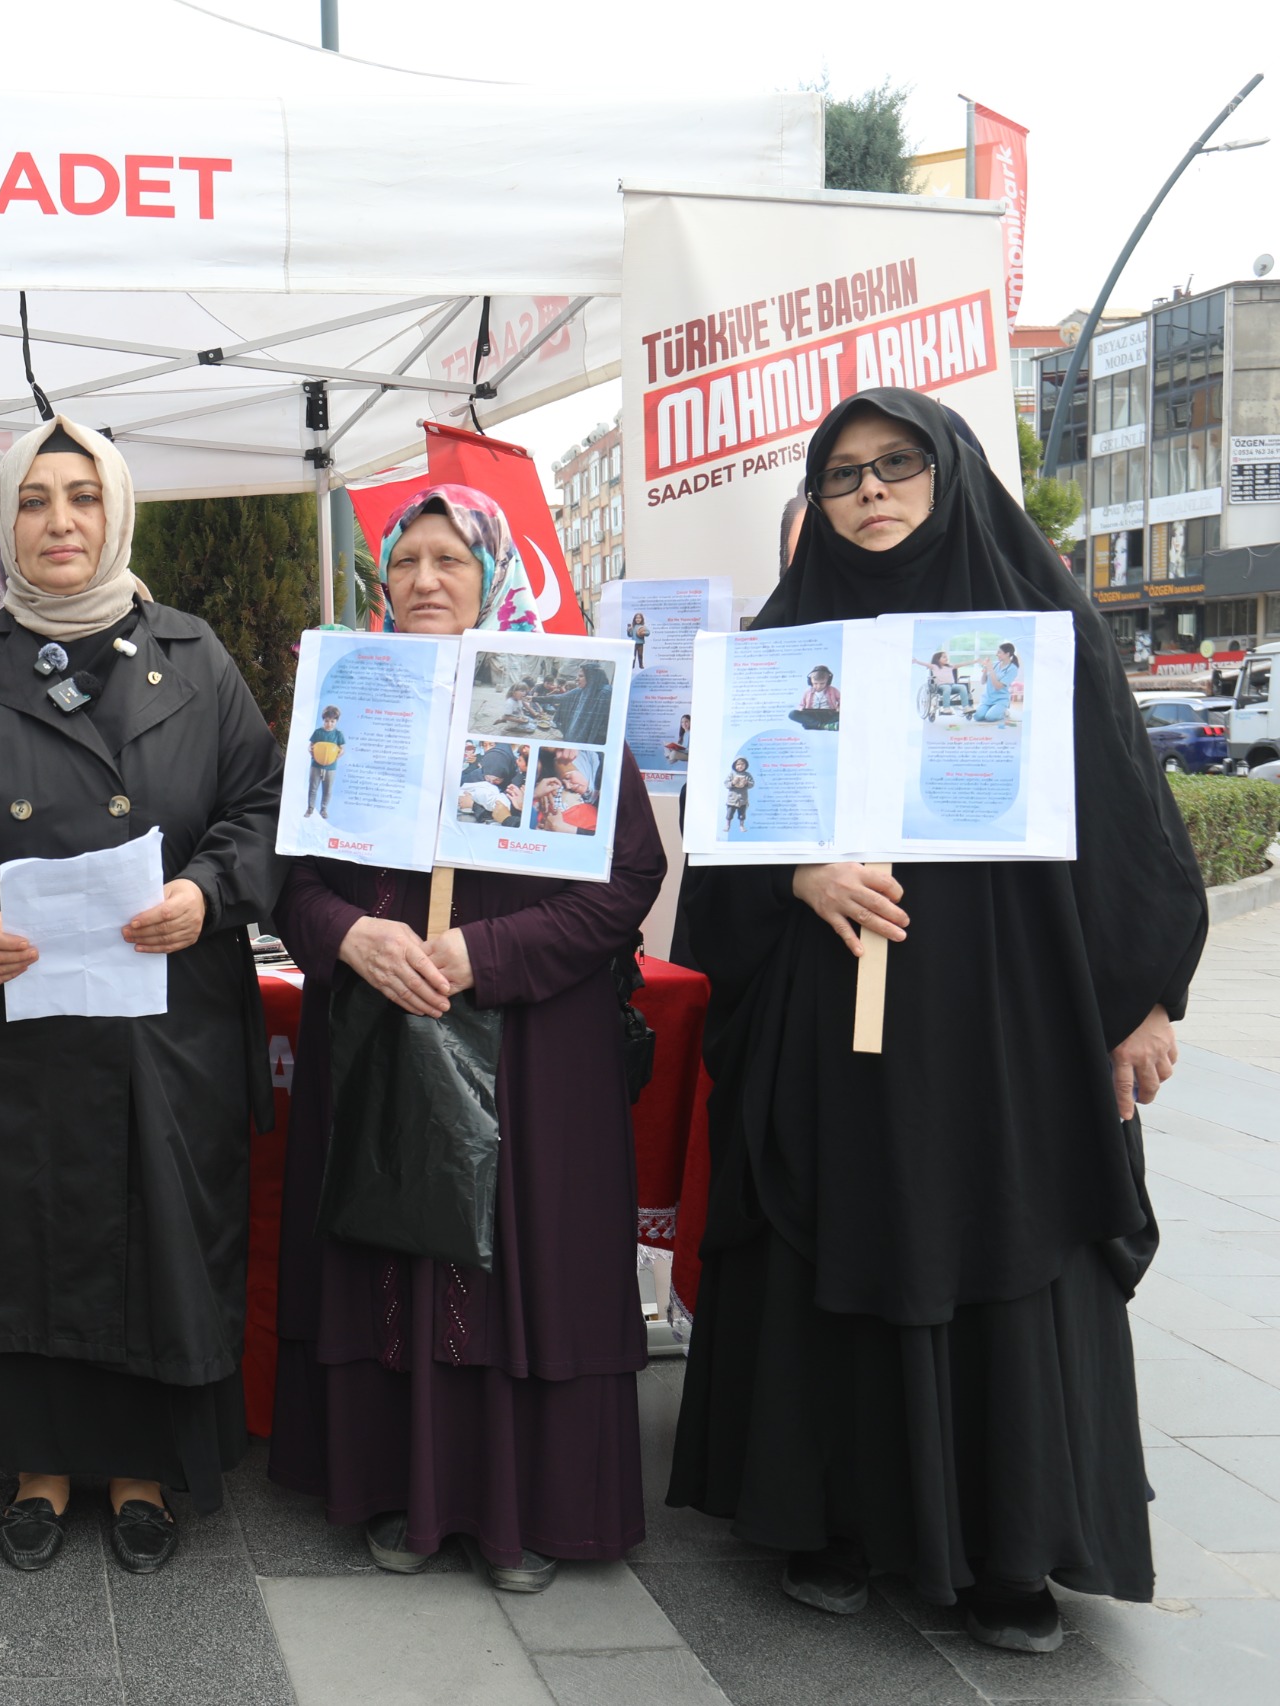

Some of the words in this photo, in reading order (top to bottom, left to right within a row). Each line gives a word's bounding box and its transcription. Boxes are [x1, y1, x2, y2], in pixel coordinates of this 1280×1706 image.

[816, 257, 918, 332] BAŞKAN
[1097, 336, 1128, 356] BEYAZ
[1105, 352, 1134, 370] MODA
[657, 341, 845, 469] MAHMUT
[856, 300, 987, 391] ARIKAN
[1234, 439, 1265, 448] ÖZGEN
[647, 465, 733, 507] SAADET
[742, 441, 806, 478] PARTİSİ
[1149, 583, 1174, 598] ÖZGEN
[339, 841, 374, 851] SAADET
[510, 841, 548, 852] SAADET
